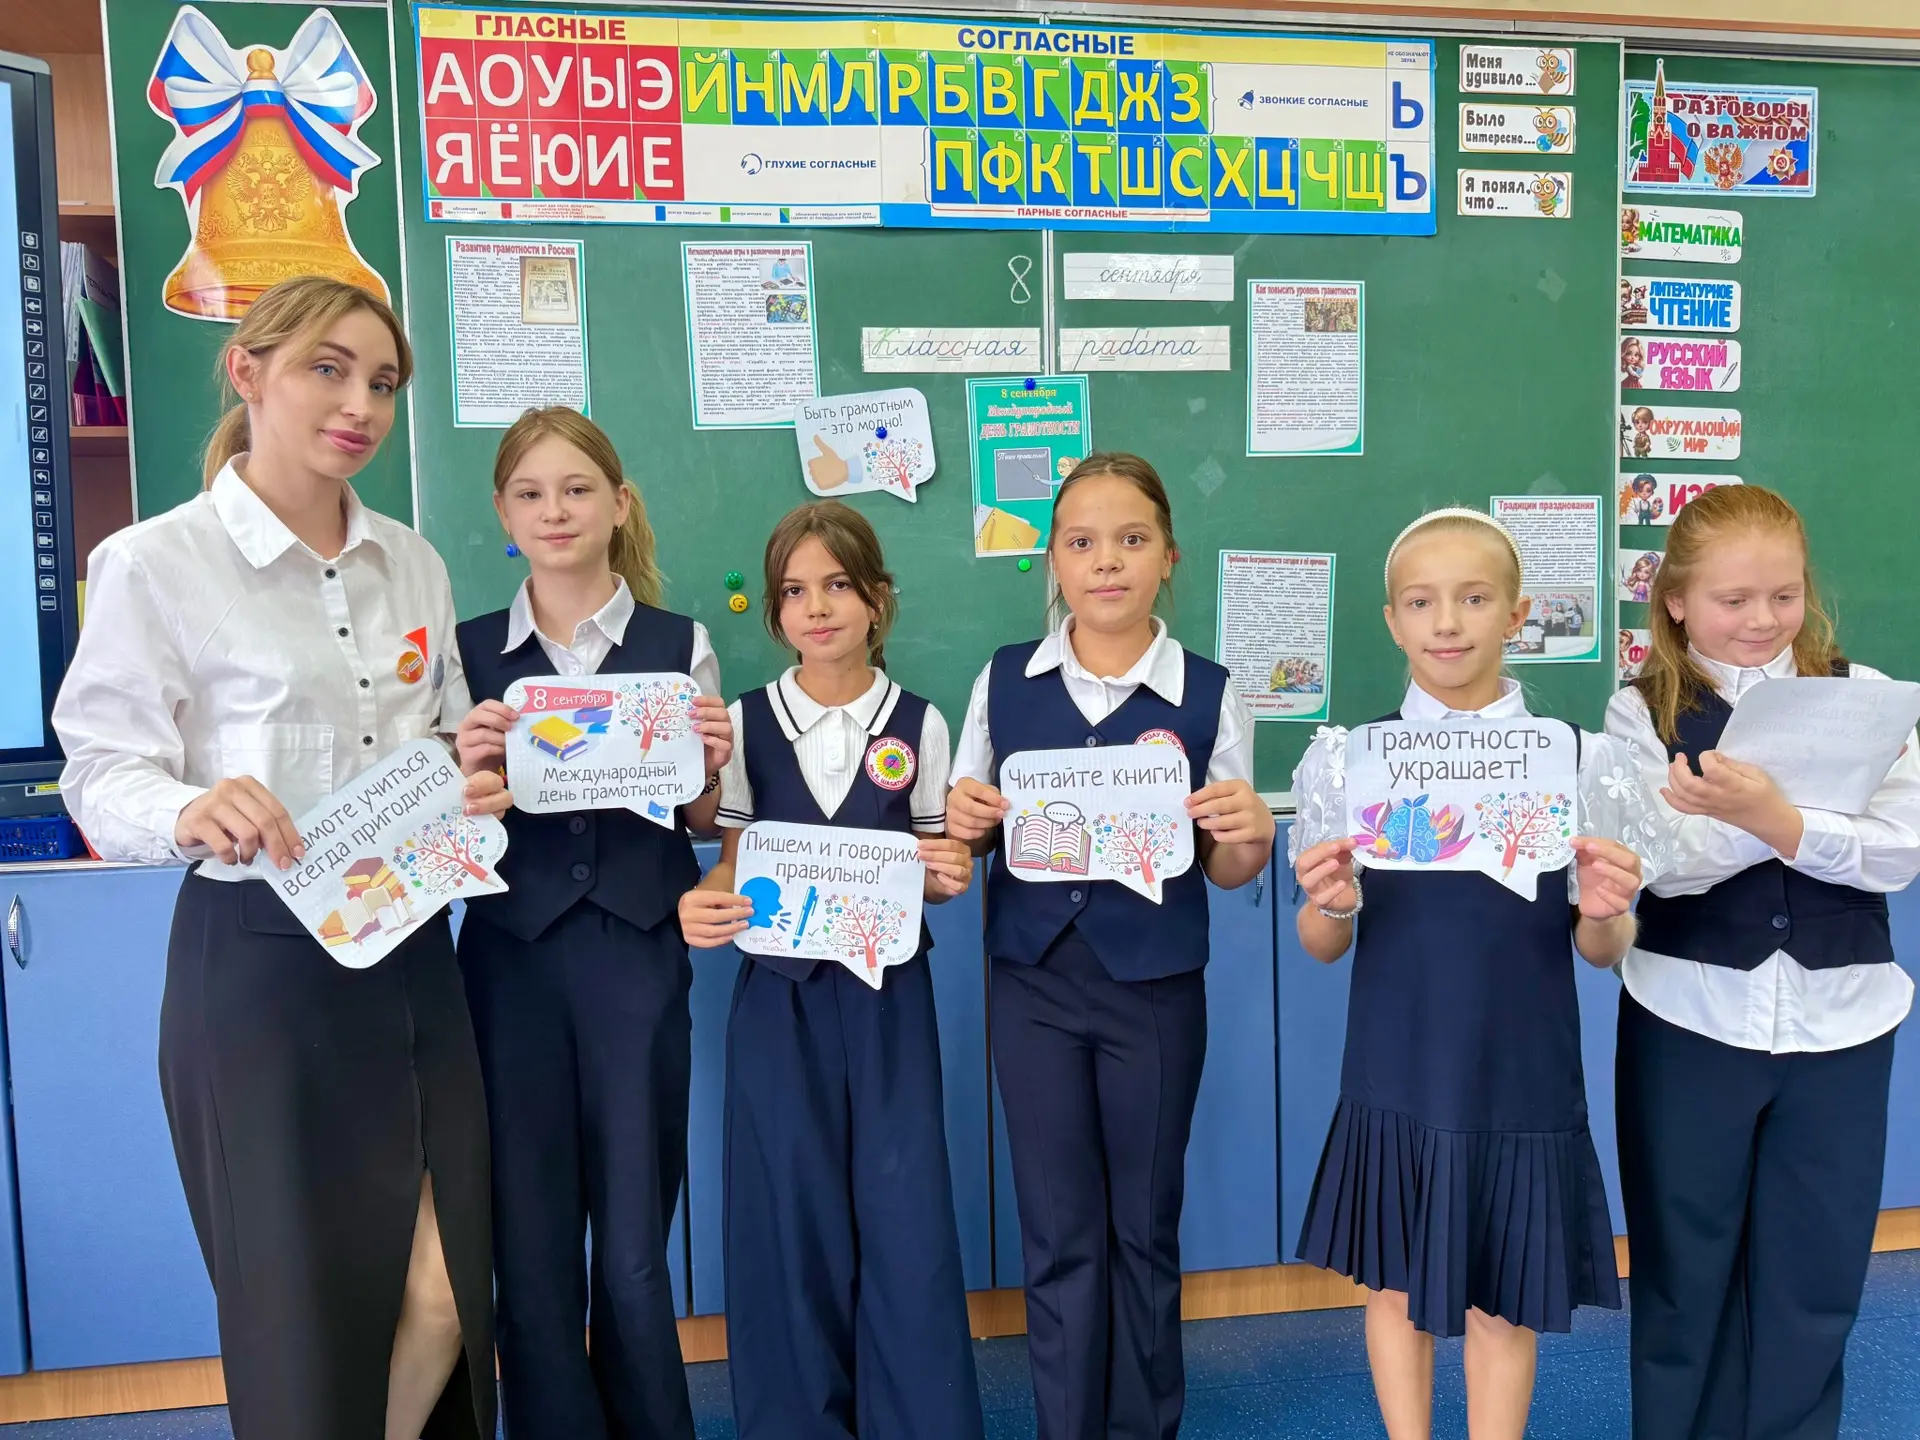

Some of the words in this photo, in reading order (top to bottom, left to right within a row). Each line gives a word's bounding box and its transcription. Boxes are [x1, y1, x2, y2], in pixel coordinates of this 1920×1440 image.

[475, 14, 626, 41] ГЛАСНЫЕ
[957, 27, 1134, 55] СОГЛАСНЫЕ
[1466, 53, 1502, 69] Меня
[1259, 94, 1304, 107] ЗВОНКИЕ
[1308, 96, 1369, 109] СОГЛАСНЫЕ
[1672, 98, 1808, 118] РАЗГОВОРЫ
[1466, 110, 1506, 127] Было
[1687, 122, 1701, 138] О
[1706, 122, 1807, 141] ВАЖНОМ
[764, 158, 808, 171] ГЛУХИЕ
[810, 158, 877, 171] СОГЛАСНЫЕ
[1466, 176, 1474, 193] Я
[1482, 178, 1531, 196] понял,
[1017, 207, 1061, 220] ПАРНЫЕ
[1064, 208, 1129, 220] СОГЛАСНЫЕ
[1638, 220, 1742, 248] МАТЕМАТИКА
[456, 240, 492, 253] Развитие
[492, 243, 540, 257] грамотности
[542, 246, 546, 254] в
[548, 244, 576, 256] России
[791, 246, 804, 257] детей
[1008, 255, 1033, 305] 8
[1100, 259, 1204, 294] сентября
[1256, 284, 1266, 294] Как
[1268, 286, 1295, 295] повысить
[1296, 286, 1320, 298] уровень
[1321, 286, 1357, 298] грамотности
[1649, 281, 1734, 300] ЛИТЕРАТУРНОЕ
[1650, 298, 1731, 328] ЧТЕНИЕ
[870, 328, 1029, 358] Классная
[1073, 328, 1204, 371] работа
[1646, 339, 1728, 368] РУССКИЙ
[1660, 366, 1713, 391] ЯЗЫК
[1000, 388, 1008, 398] 8
[1010, 387, 1056, 400] сентября
[804, 406, 836, 420] Быть
[840, 399, 914, 420] грамотным
[988, 401, 1073, 420] Международный
[832, 423, 854, 434] это
[980, 423, 1008, 440] ДЕНЬ
[1008, 420, 1080, 437] ГРАМОТНОСТИ
[1650, 419, 1741, 438] ОКРУЖАЮЩИЙ
[1684, 438, 1709, 453] МИР
[1498, 500, 1537, 512] Традиции
[1538, 500, 1595, 512] празднования
[1669, 482, 1717, 515] ИЗ
[533, 688, 548, 710] 8
[553, 692, 608, 709] сентября
[1367, 726, 1552, 760] Грамотность
[357, 750, 430, 813] учиться
[543, 761, 677, 785] Международный
[1008, 766, 1104, 790] Читайте
[1112, 760, 1184, 786] книги!
[1388, 753, 1528, 790] украшает!
[538, 788, 577, 805] день
[582, 782, 684, 804] грамотности
[282, 840, 352, 898] всегда
[351, 764, 454, 846] пригодится
[746, 830, 812, 856] Пишем
[820, 842, 831, 857] и
[838, 842, 921, 868] говорим
[776, 862, 880, 885] правильно!
